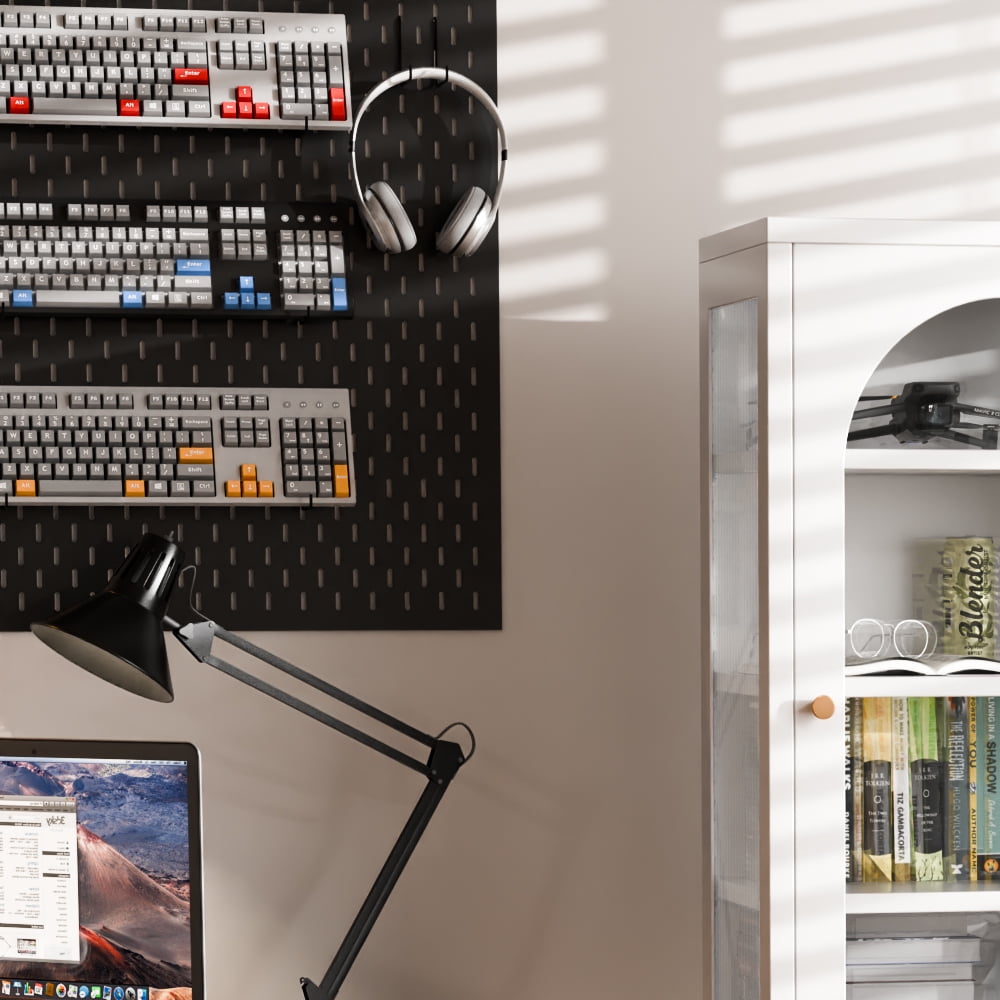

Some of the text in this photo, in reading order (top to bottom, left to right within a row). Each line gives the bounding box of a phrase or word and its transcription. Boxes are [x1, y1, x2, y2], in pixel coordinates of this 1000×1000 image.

[959, 544, 984, 643] Blender
[987, 696, 996, 723] LIVING
[987, 724, 996, 733] IN
[969, 741, 977, 768] YOU
[986, 741, 997, 794] SHADOW
[948, 721, 965, 851] THE REFLECTION HUGO WILCKEN
[896, 792, 905, 860] TIZ GAMBACORTA
